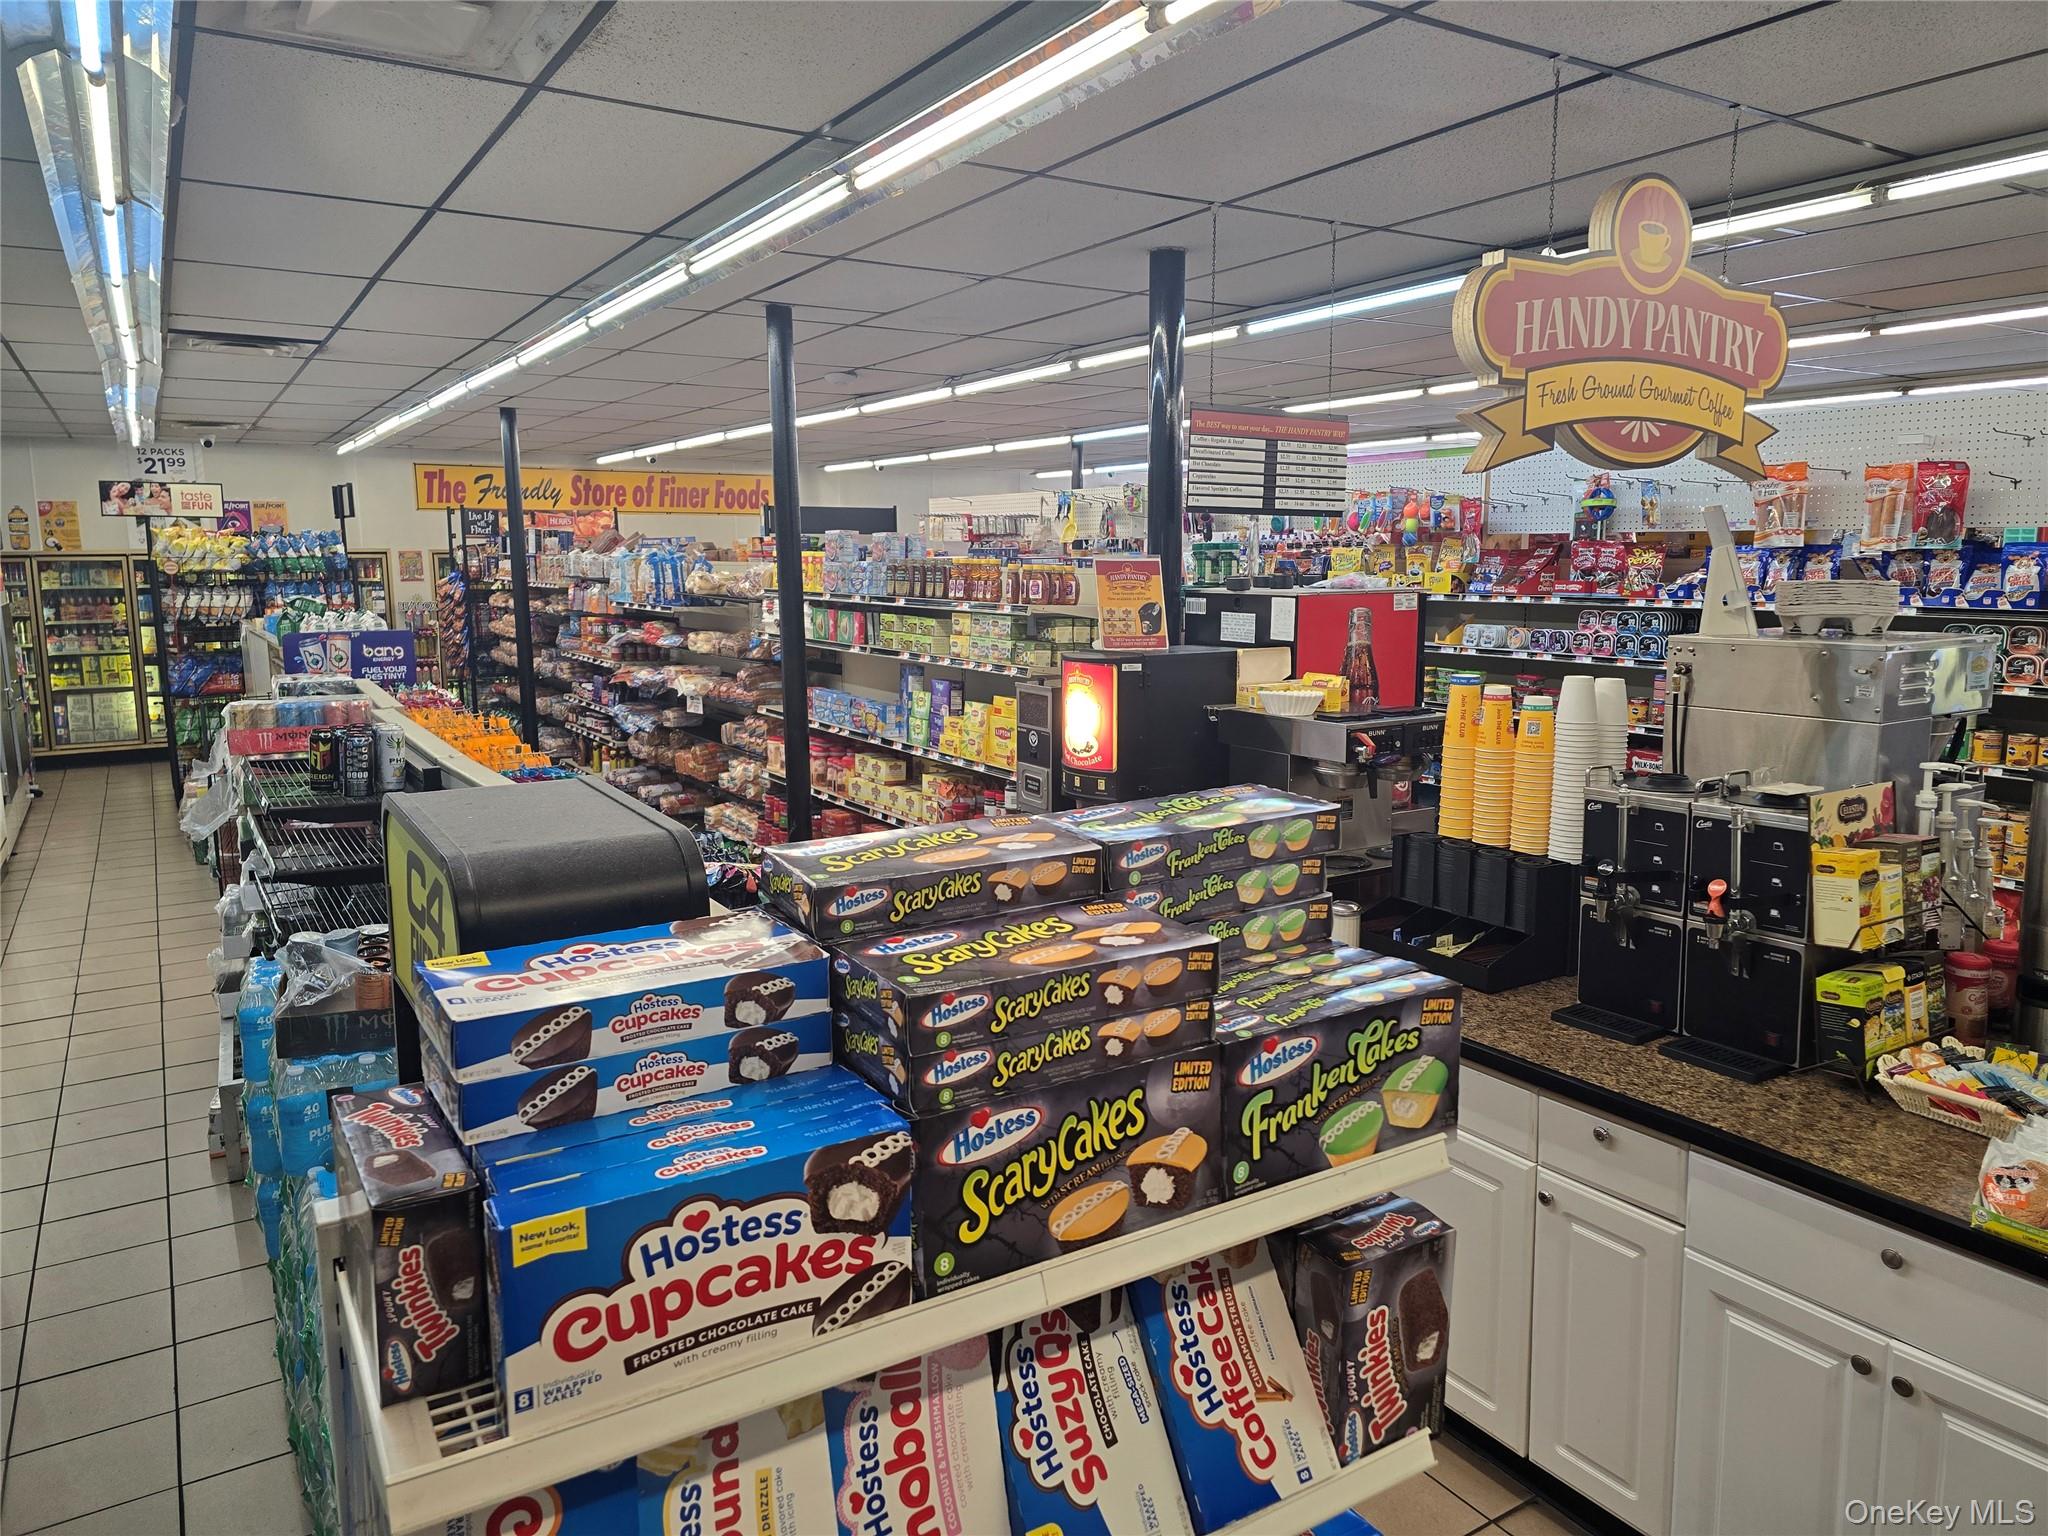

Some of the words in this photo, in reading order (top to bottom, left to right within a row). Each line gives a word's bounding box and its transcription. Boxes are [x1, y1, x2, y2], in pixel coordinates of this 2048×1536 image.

[1514, 296, 1641, 356] HANDY
[1643, 300, 1764, 377] PANTRY
[1536, 380, 1577, 408] Fresh
[1582, 375, 1636, 400] Ground
[1639, 376, 1698, 407] Gourmet
[1697, 387, 1734, 428] Coffee
[1206, 421, 1221, 429] BEST
[1288, 427, 1309, 435] HANDY
[1309, 428, 1332, 437] PANTRY
[137, 448, 147, 456] 12
[150, 448, 185, 456] PACKS
[181, 491, 212, 501] taste
[423, 470, 466, 504] The
[473, 474, 563, 503] Frindly
[571, 475, 626, 506] Store
[633, 477, 654, 507] of
[659, 477, 709, 508] Finer
[714, 481, 769, 510] Foods
[192, 502, 212, 510] FUN
[469, 512, 482, 521] Live
[483, 510, 495, 523] Life
[362, 644, 404, 658] bang
[361, 667, 381, 675] FUEL
[381, 666, 407, 674] YOUR
[365, 672, 406, 680] DESTINY!
[1071, 755, 1102, 766] Chocolate
[1316, 822, 1335, 830] EDITION
[1317, 815, 1336, 823] LIMITED
[820, 827, 980, 873] ScaryCakes
[1072, 857, 1096, 866] LIMITED
[1125, 844, 1165, 867] Hostess
[1167, 828, 1246, 876] FrankenCakes
[1303, 859, 1321, 867] LIMITED
[1071, 865, 1095, 874] EDITION
[836, 888, 885, 915] Hostess
[890, 872, 982, 923] ScaryCakes
[539, 941, 683, 968] Hostess
[877, 931, 951, 954] Hostess
[902, 916, 1073, 975] ScaryCakes
[1188, 951, 1213, 961] LIMITED
[474, 942, 763, 992] Cupcakes
[1187, 960, 1212, 970] EDITION
[634, 996, 678, 1013] Hostess
[931, 994, 986, 1025] Hostess
[991, 971, 1090, 1033] ScaryCakes
[1185, 1010, 1209, 1020] EDITION
[1423, 998, 1454, 1011] LIMITED
[612, 1007, 701, 1034] Cupcakes
[1421, 1011, 1453, 1025] EDITION
[623, 1032, 645, 1041] FROSTED
[645, 1026, 676, 1037] CHOCOLATE
[639, 1054, 683, 1071] Hostess
[933, 1049, 987, 1083] Hostess
[992, 1025, 1091, 1087] ScaryCakes
[1174, 1060, 1212, 1076] LIMITED
[1250, 1037, 1313, 1084] Hostess
[617, 1063, 706, 1092] Cupcakes
[628, 1090, 650, 1098] FROSTED
[650, 1084, 680, 1095] CHOCOLATE
[681, 1080, 695, 1088] CAKE
[1172, 1075, 1210, 1092] EDITION
[1242, 1019, 1419, 1160] FrankenCakes
[303, 1102, 319, 1113] 40
[632, 1099, 731, 1126] Cupcakes
[651, 1121, 752, 1148] Cupcakes
[953, 1109, 1037, 1163] Hostess
[658, 1147, 765, 1178] Cupcakes
[958, 1088, 1145, 1244] ScaryCakes
[1060, 1163, 1101, 1195] SCREAM
[519, 1230, 547, 1243] New
[520, 1243, 543, 1252] same
[545, 1233, 580, 1249] favorite!
[640, 1209, 803, 1278] Hostess
[962, 1275, 980, 1286] cakes
[1350, 1270, 1363, 1305] LIMITED
[1359, 1269, 1371, 1304] EDITION
[382, 1290, 397, 1323] SPOOKY
[392, 1244, 460, 1363] Twinkies
[553, 1236, 876, 1362] Cupcakes
[1219, 1269, 1239, 1325] STREUSEL
[633, 1334, 696, 1368] FROSTED
[698, 1309, 777, 1342] CHOCOLATE
[781, 1302, 813, 1317] CAKE
[673, 1352, 699, 1368] with
[702, 1339, 743, 1360] creamy
[747, 1327, 778, 1344] filling
[1248, 1326, 1261, 1352] coffee
[391, 1339, 408, 1384] Hostess
[1080, 1340, 1092, 1366] CAKE
[1171, 1284, 1223, 1416] Hostess
[1187, 1257, 1277, 1470] CoffeeCak
[1236, 1328, 1262, 1389] CINNAMON
[543, 1373, 603, 1398] WRAPPED
[1095, 1351, 1108, 1393] creamy
[1107, 1366, 1120, 1399] filling
[1346, 1360, 1358, 1403] SPOOKY
[1359, 1305, 1407, 1444] Twinkies
[544, 1387, 583, 1405] CAKES
[955, 1384, 965, 1426] filling
[1029, 1308, 1108, 1494] SuzyQ's
[1084, 1367, 1112, 1441] CHOCOLATE
[1119, 1358, 1149, 1423] MEGA-SIZED
[1141, 1383, 1152, 1408] snack
[929, 1362, 945, 1459] MARSHMALLOW
[1017, 1345, 1064, 1480] Hostess
[1103, 1396, 1118, 1420] with
[947, 1402, 959, 1461] chocolate
[939, 1461, 946, 1469] &
[776, 1466, 784, 1494] cake
[955, 1463, 967, 1509] covered
[760, 1475, 771, 1530] DRIZZLE
[787, 1493, 796, 1515] icing
[940, 1470, 957, 1529] COCONUT
